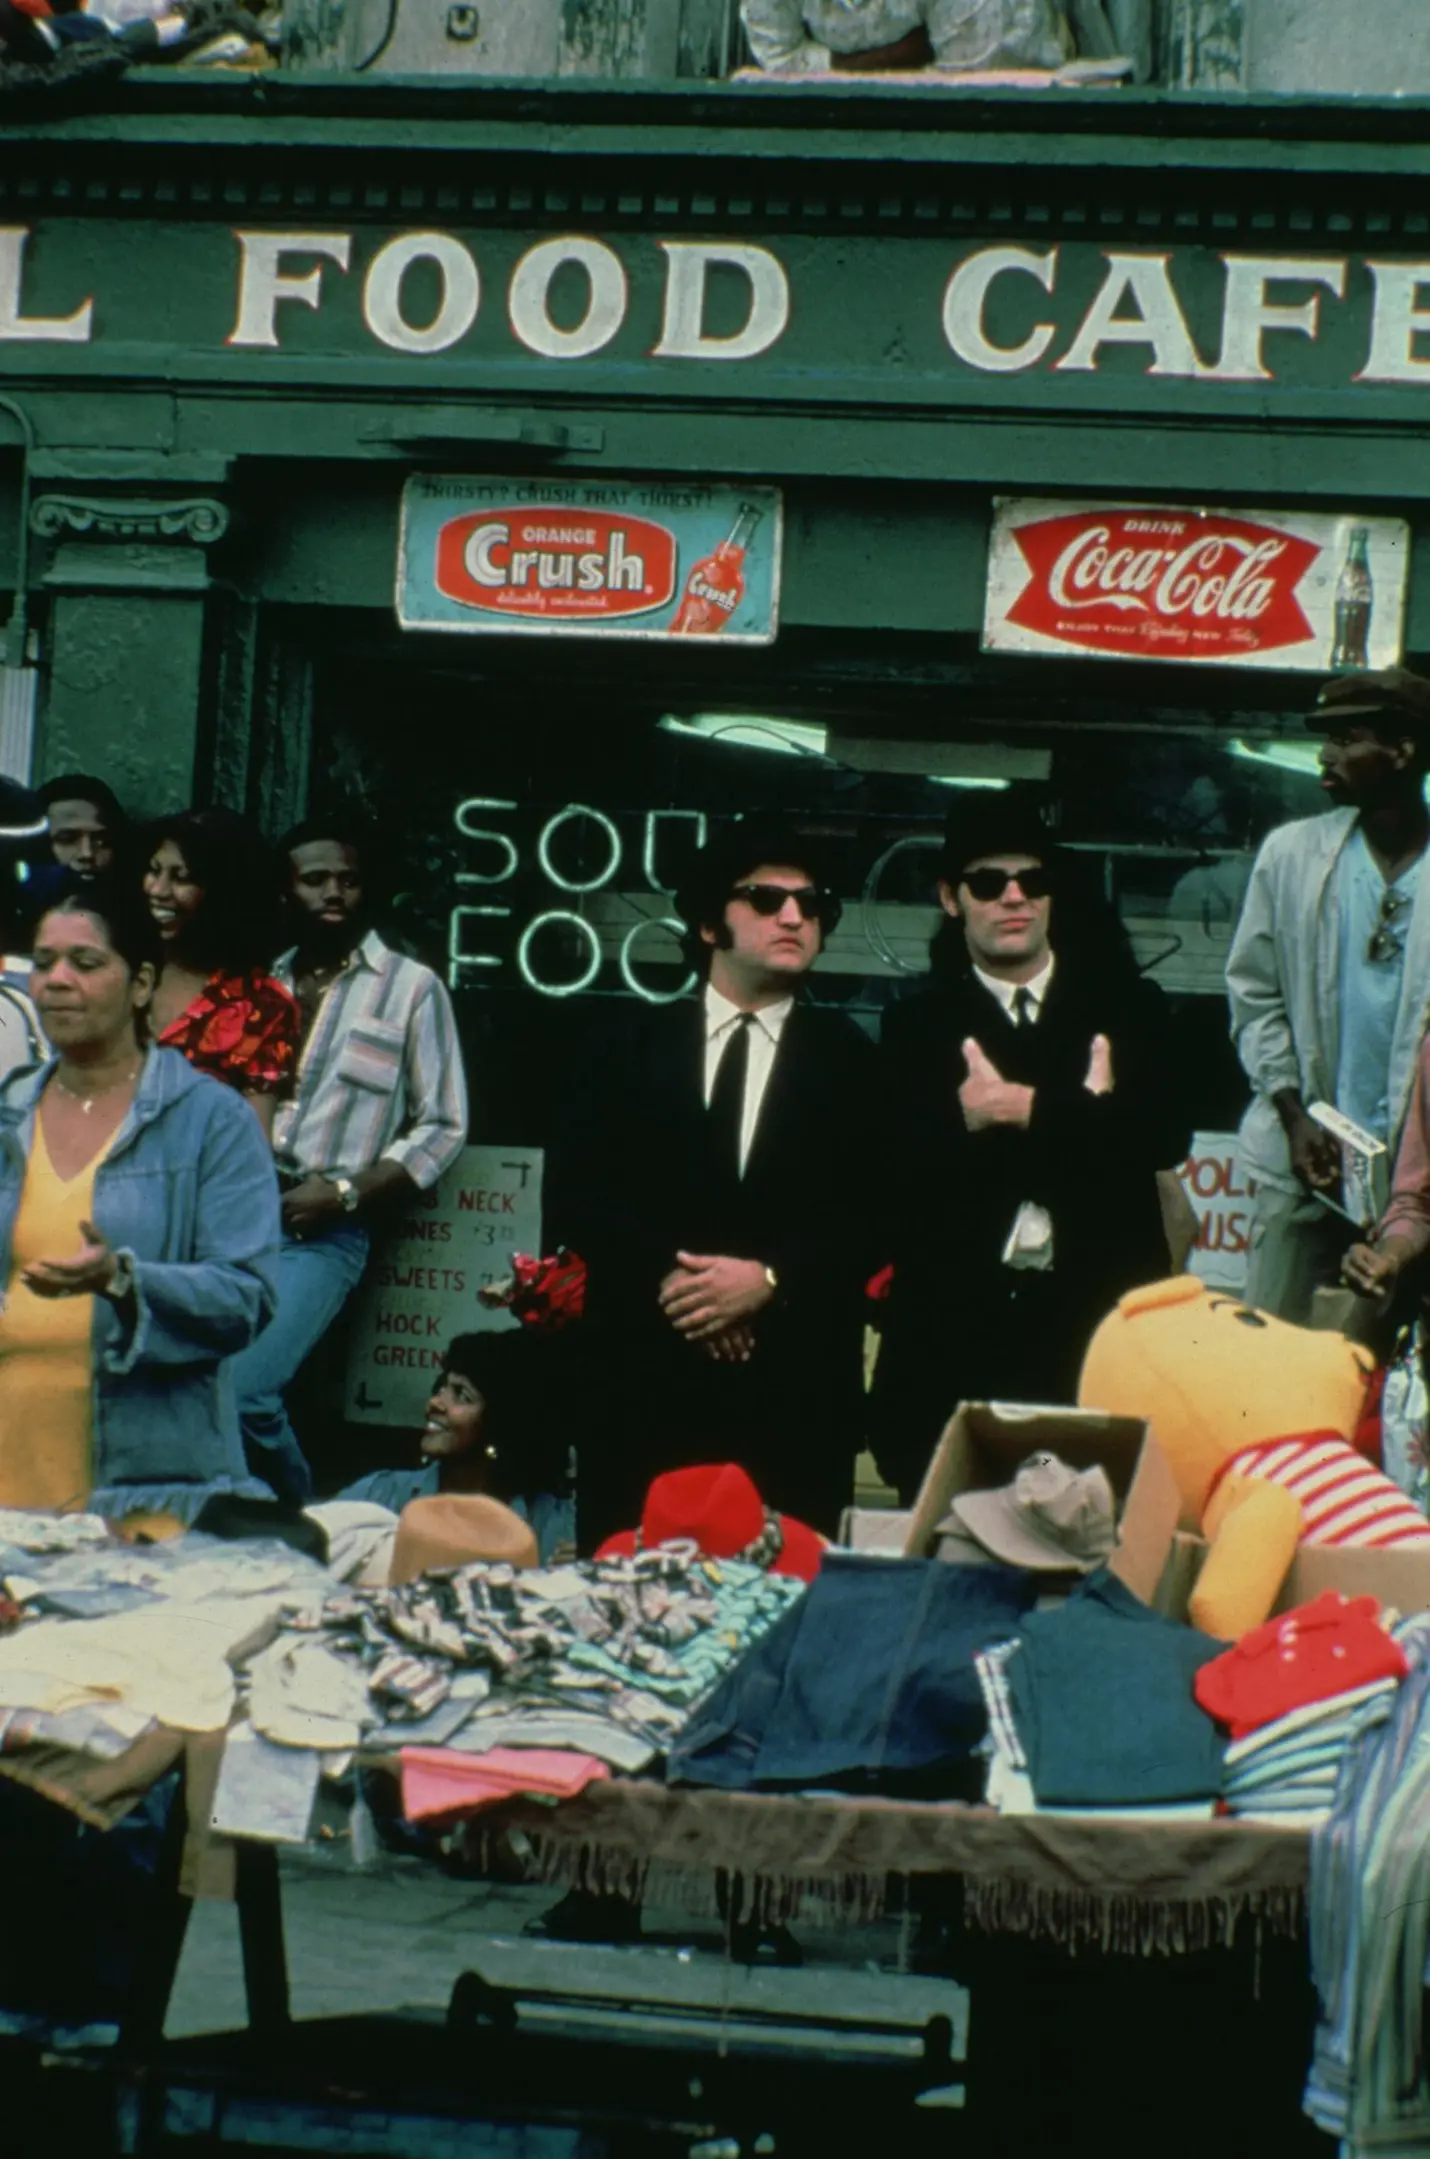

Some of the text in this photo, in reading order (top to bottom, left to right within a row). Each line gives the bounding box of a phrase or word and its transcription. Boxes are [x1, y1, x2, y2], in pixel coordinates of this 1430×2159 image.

[226, 229, 790, 361] FOOD
[941, 244, 1430, 383] CAFE
[515, 484, 576, 505] CRUSH
[582, 487, 630, 506] THAT
[521, 524, 598, 546] ORANGE
[1123, 518, 1187, 536] DRINK
[463, 522, 644, 591] Crush
[1048, 525, 1289, 620] Coca-Cola
[687, 571, 737, 611] Crush
[454, 798, 707, 893] SOU
[448, 904, 699, 1003] FOO
[458, 1189, 517, 1215] NECK
[400, 1219, 453, 1243] NES
[378, 1266, 466, 1293] SWEETS
[375, 1312, 442, 1337] HOCK
[372, 1345, 446, 1370] GREEN
